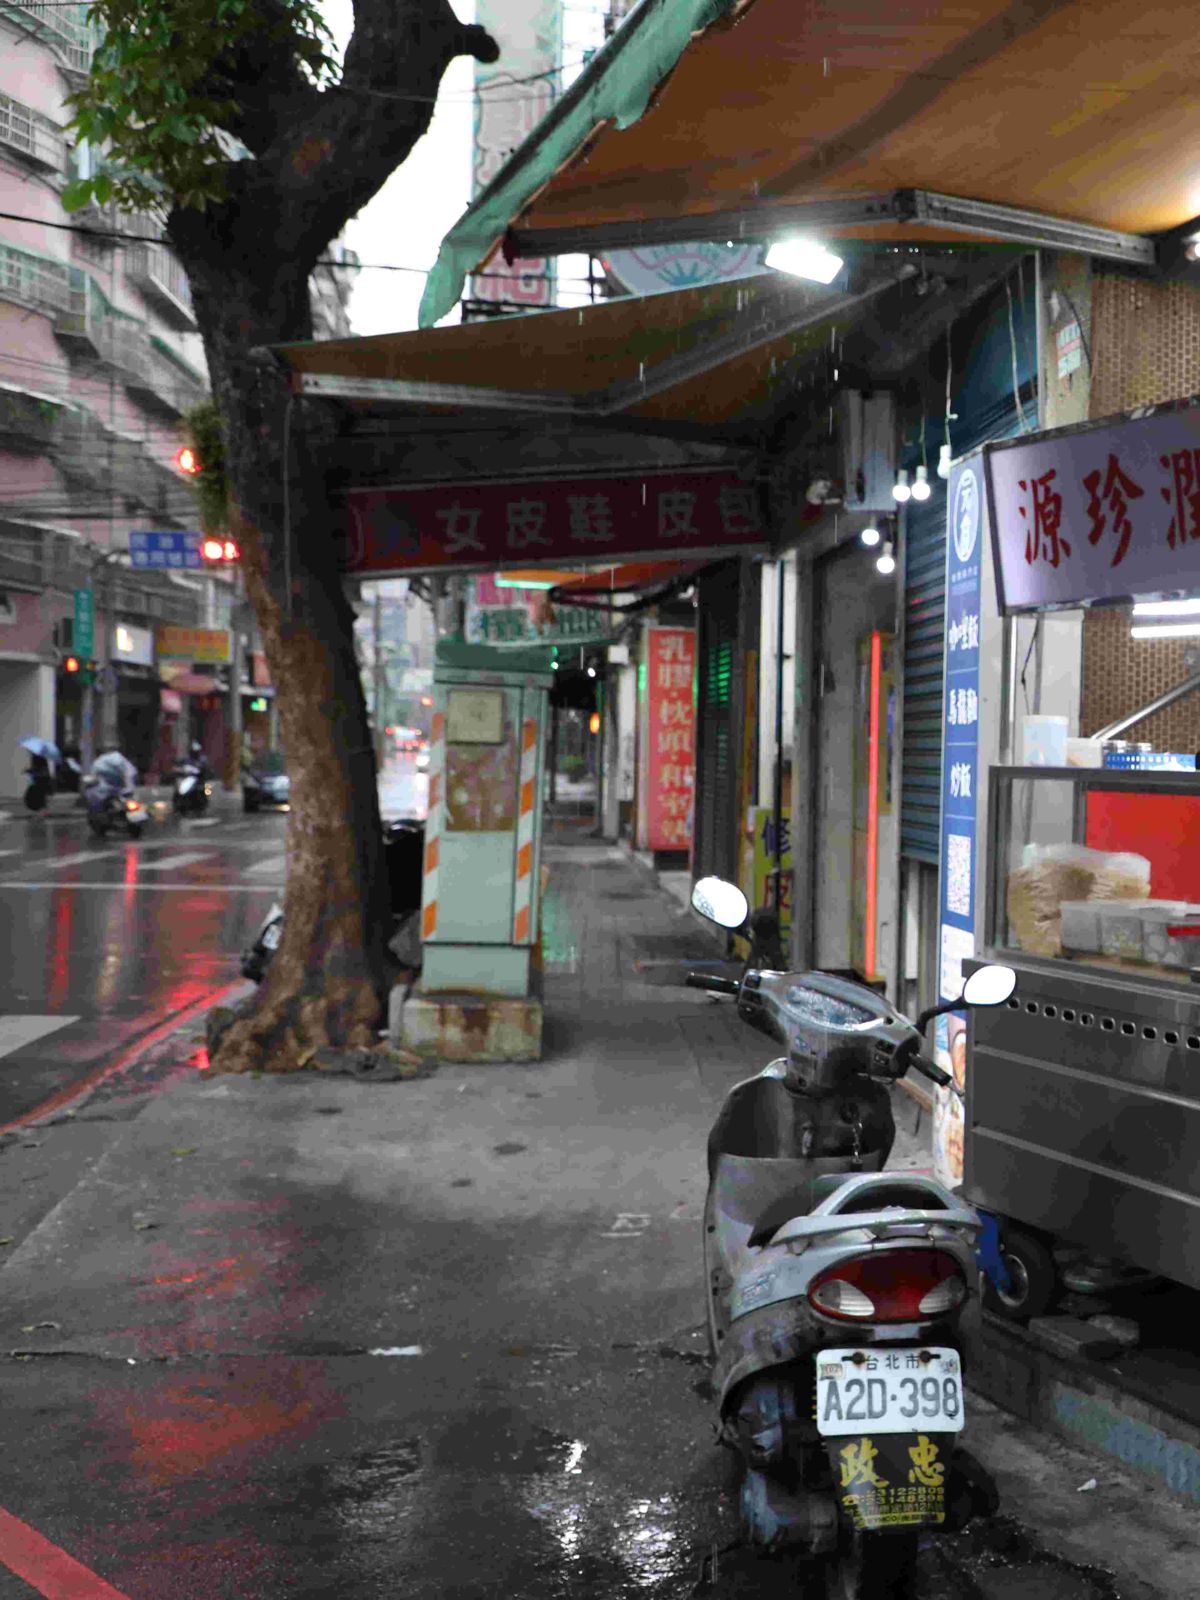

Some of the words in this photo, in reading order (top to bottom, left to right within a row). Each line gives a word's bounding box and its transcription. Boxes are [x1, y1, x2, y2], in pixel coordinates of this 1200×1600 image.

[437, 494, 616, 552] 女皮鞋
[658, 486, 761, 537] 皮包
[866, 1354, 920, 1371] 台北市
